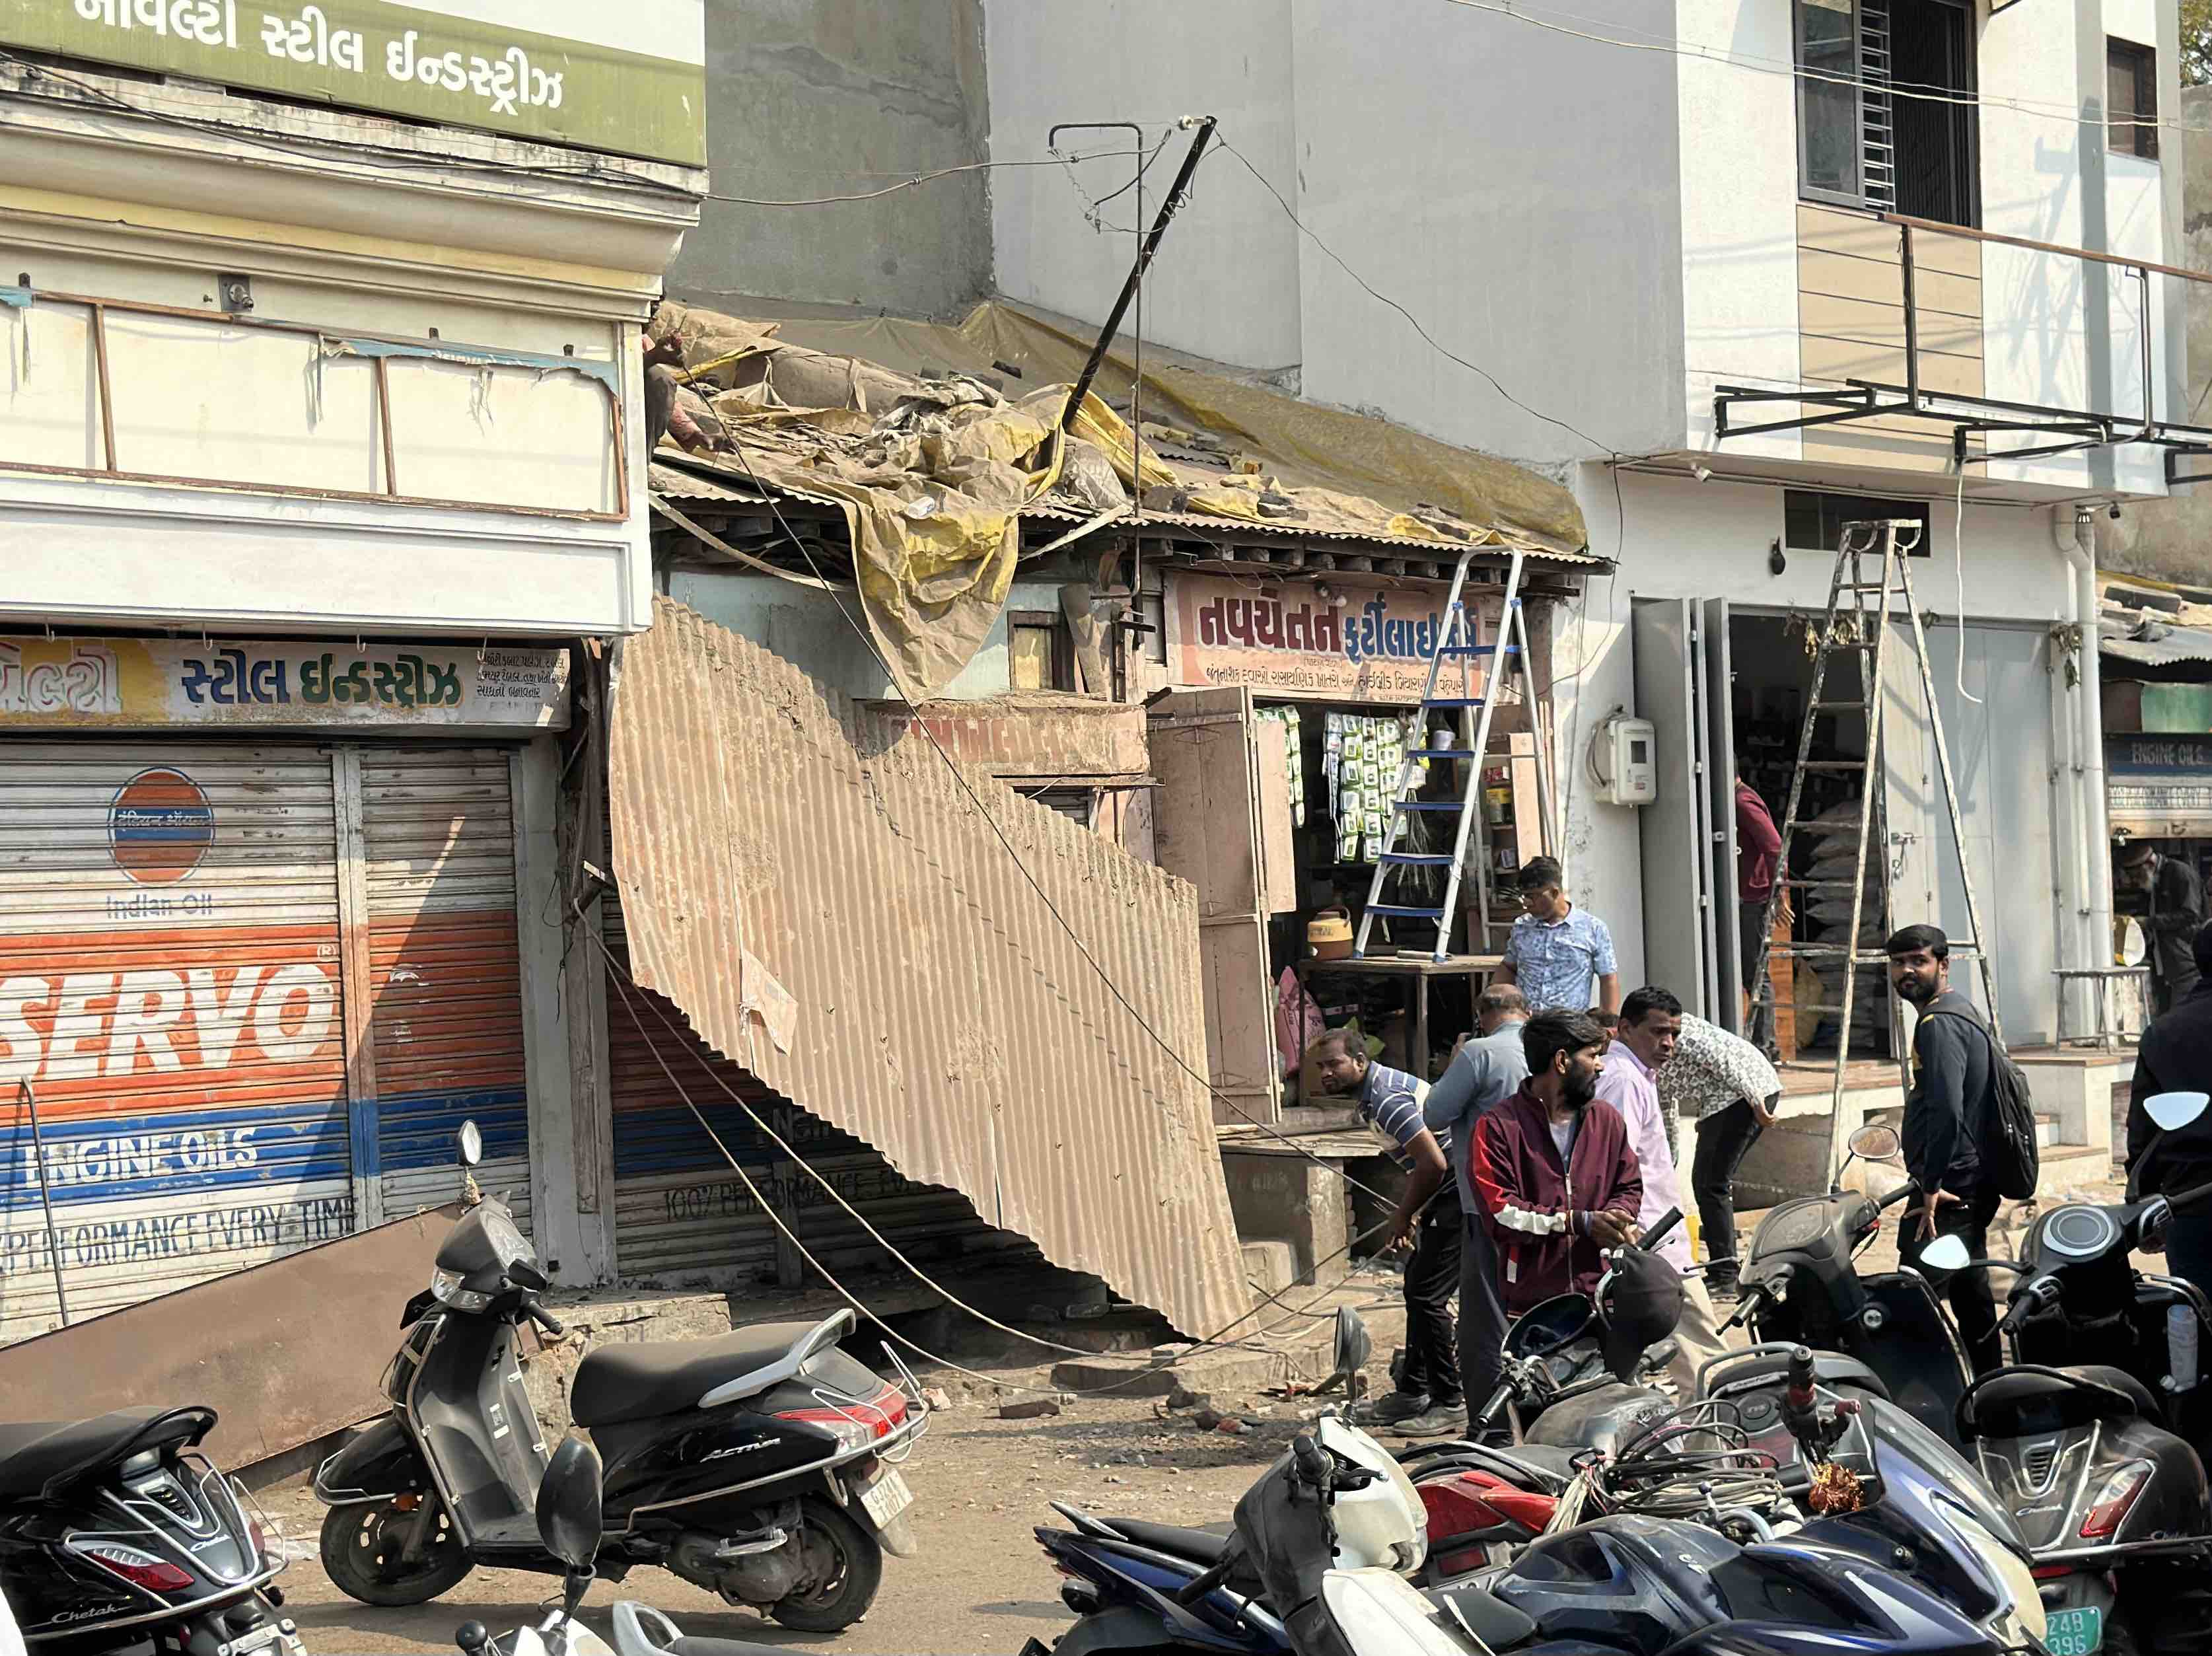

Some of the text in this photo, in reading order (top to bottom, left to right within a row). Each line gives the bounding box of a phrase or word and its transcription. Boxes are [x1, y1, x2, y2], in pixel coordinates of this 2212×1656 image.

[261, 5, 364, 73] સ્ટીલ
[1199, 589, 1343, 653] નવચેતન
[181, 649, 291, 704] સ્ટીલ
[2131, 742, 2176, 766] ENGINE
[106, 894, 213, 919] Indian Oil
[0, 964, 335, 1083] SERVO
[24, 1126, 258, 1188] ENGINE OILS
[8, 1213, 202, 1271] PERFORMANCE
[205, 1202, 285, 1248] EVERY
[50, 1603, 132, 1624] Chetak
